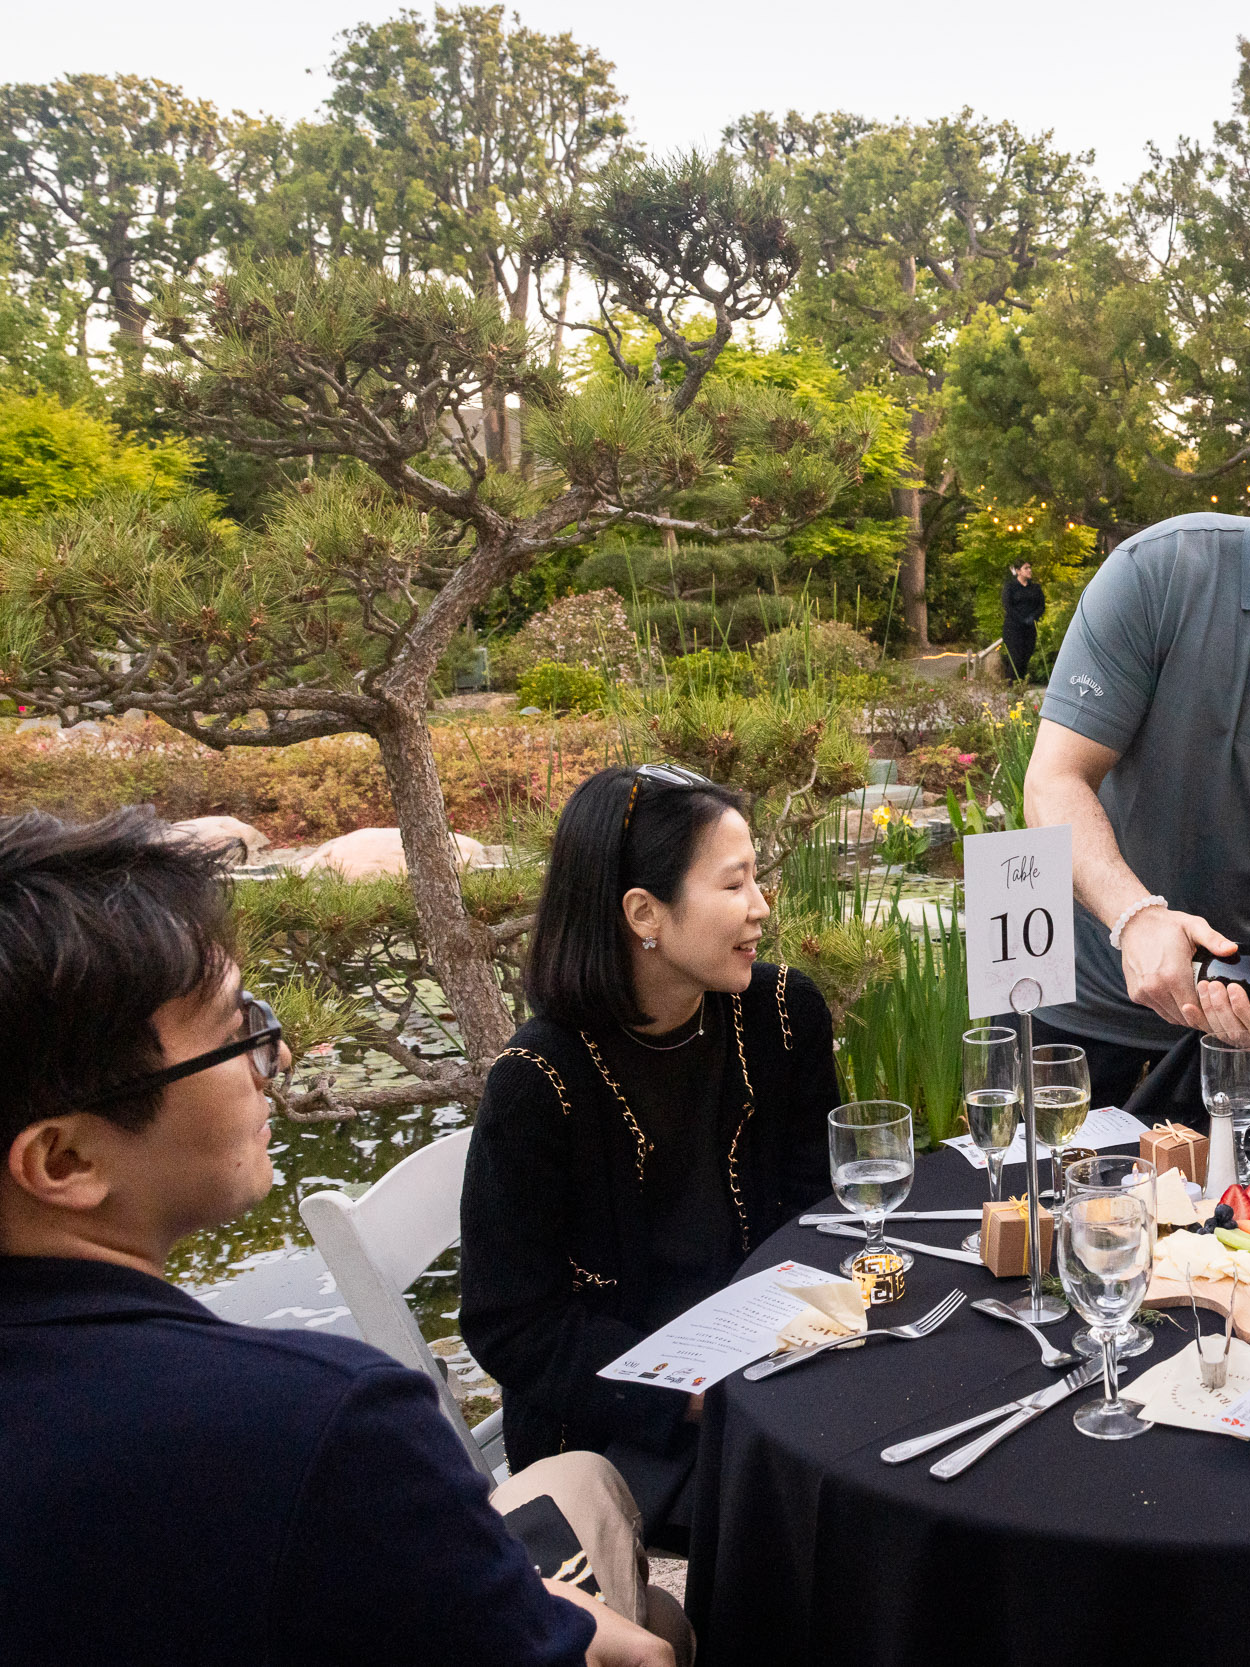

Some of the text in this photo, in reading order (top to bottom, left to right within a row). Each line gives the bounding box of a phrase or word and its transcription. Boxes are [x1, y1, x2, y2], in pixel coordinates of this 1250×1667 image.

[1070, 674, 1104, 696] Callaway
[1001, 855, 1040, 889] Table
[990, 907, 1054, 964] 10
